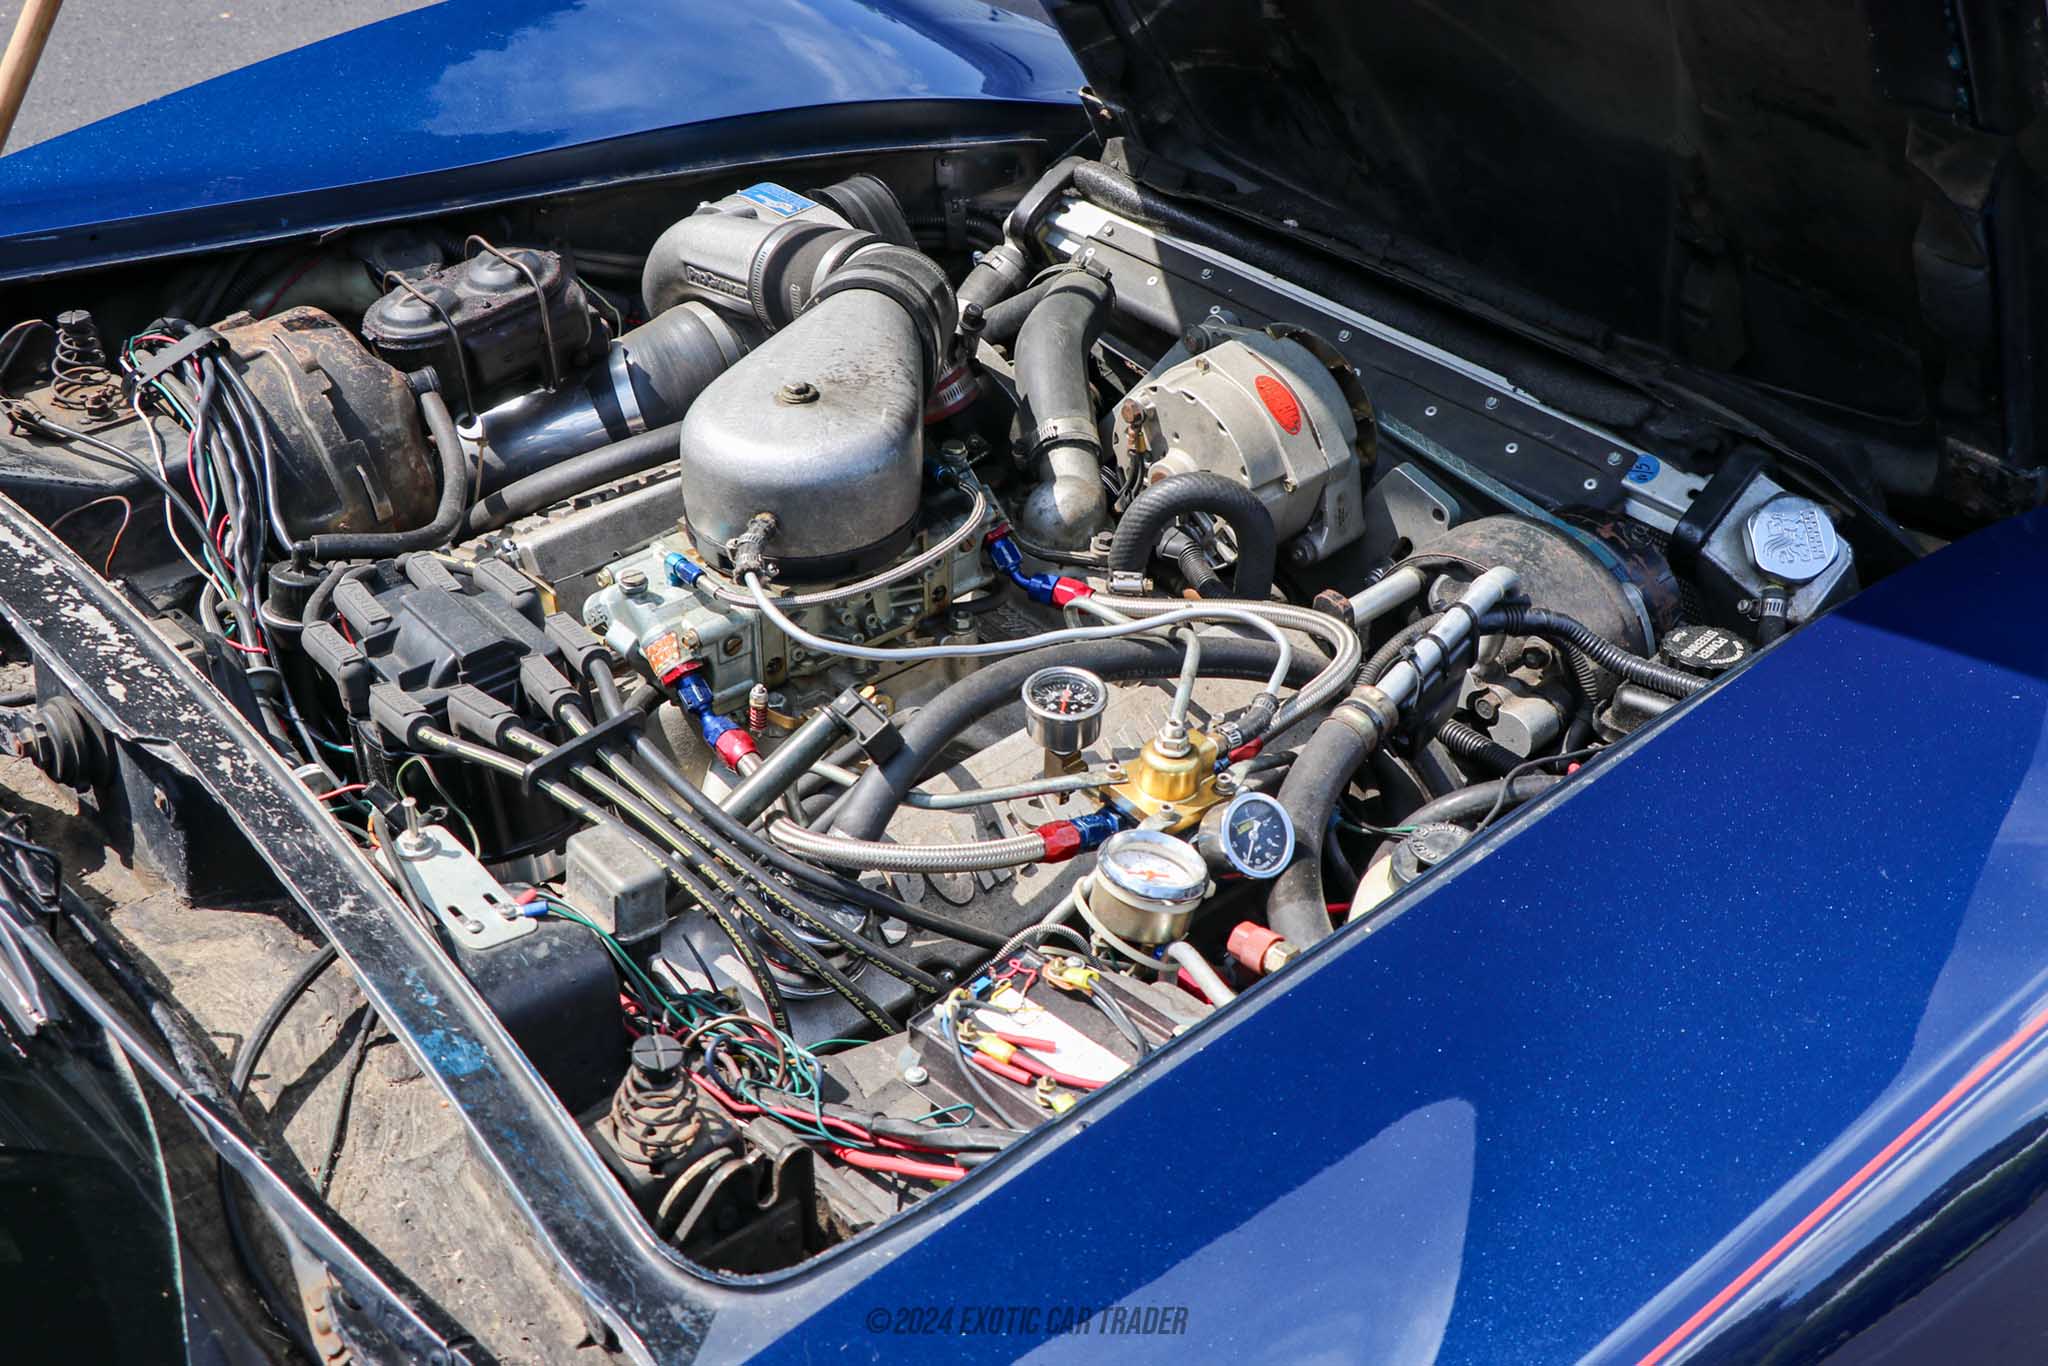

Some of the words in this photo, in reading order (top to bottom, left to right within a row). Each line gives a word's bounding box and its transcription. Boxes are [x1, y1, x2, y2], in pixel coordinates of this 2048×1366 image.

[1680, 629, 1719, 658] STEERING
[1696, 636, 1729, 659] POWER
[735, 896, 770, 928] 300+
